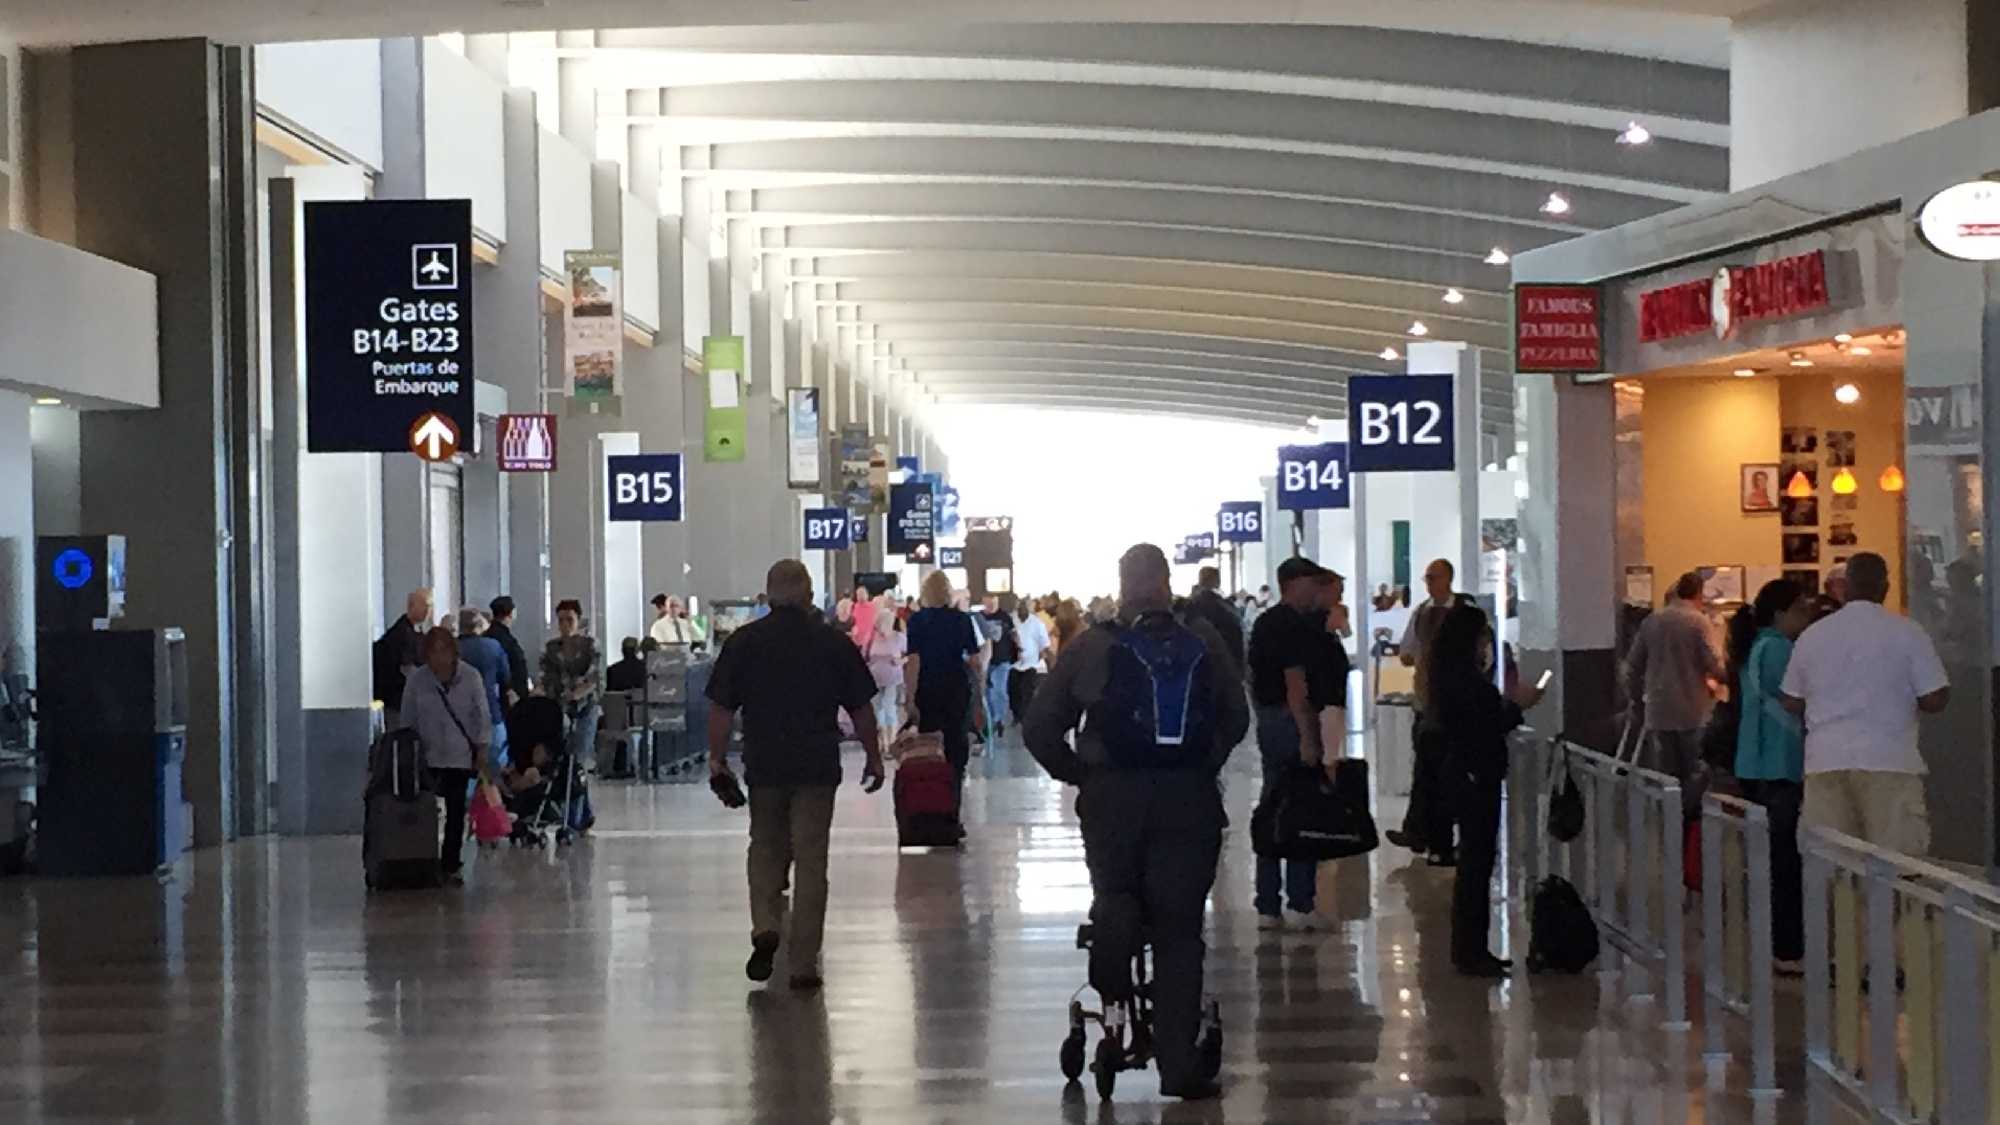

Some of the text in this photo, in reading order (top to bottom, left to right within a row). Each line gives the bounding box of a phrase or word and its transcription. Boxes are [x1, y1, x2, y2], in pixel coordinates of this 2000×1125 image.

[380, 297, 459, 322] Gates
[353, 327, 459, 354] B14-B23
[372, 359, 459, 376] Puertas de
[375, 379, 459, 397] Embarque
[1360, 401, 1442, 445] B12
[615, 471, 673, 504] B15
[1284, 459, 1343, 492] B14
[808, 518, 845, 540] B17
[1221, 510, 1259, 532] B16
